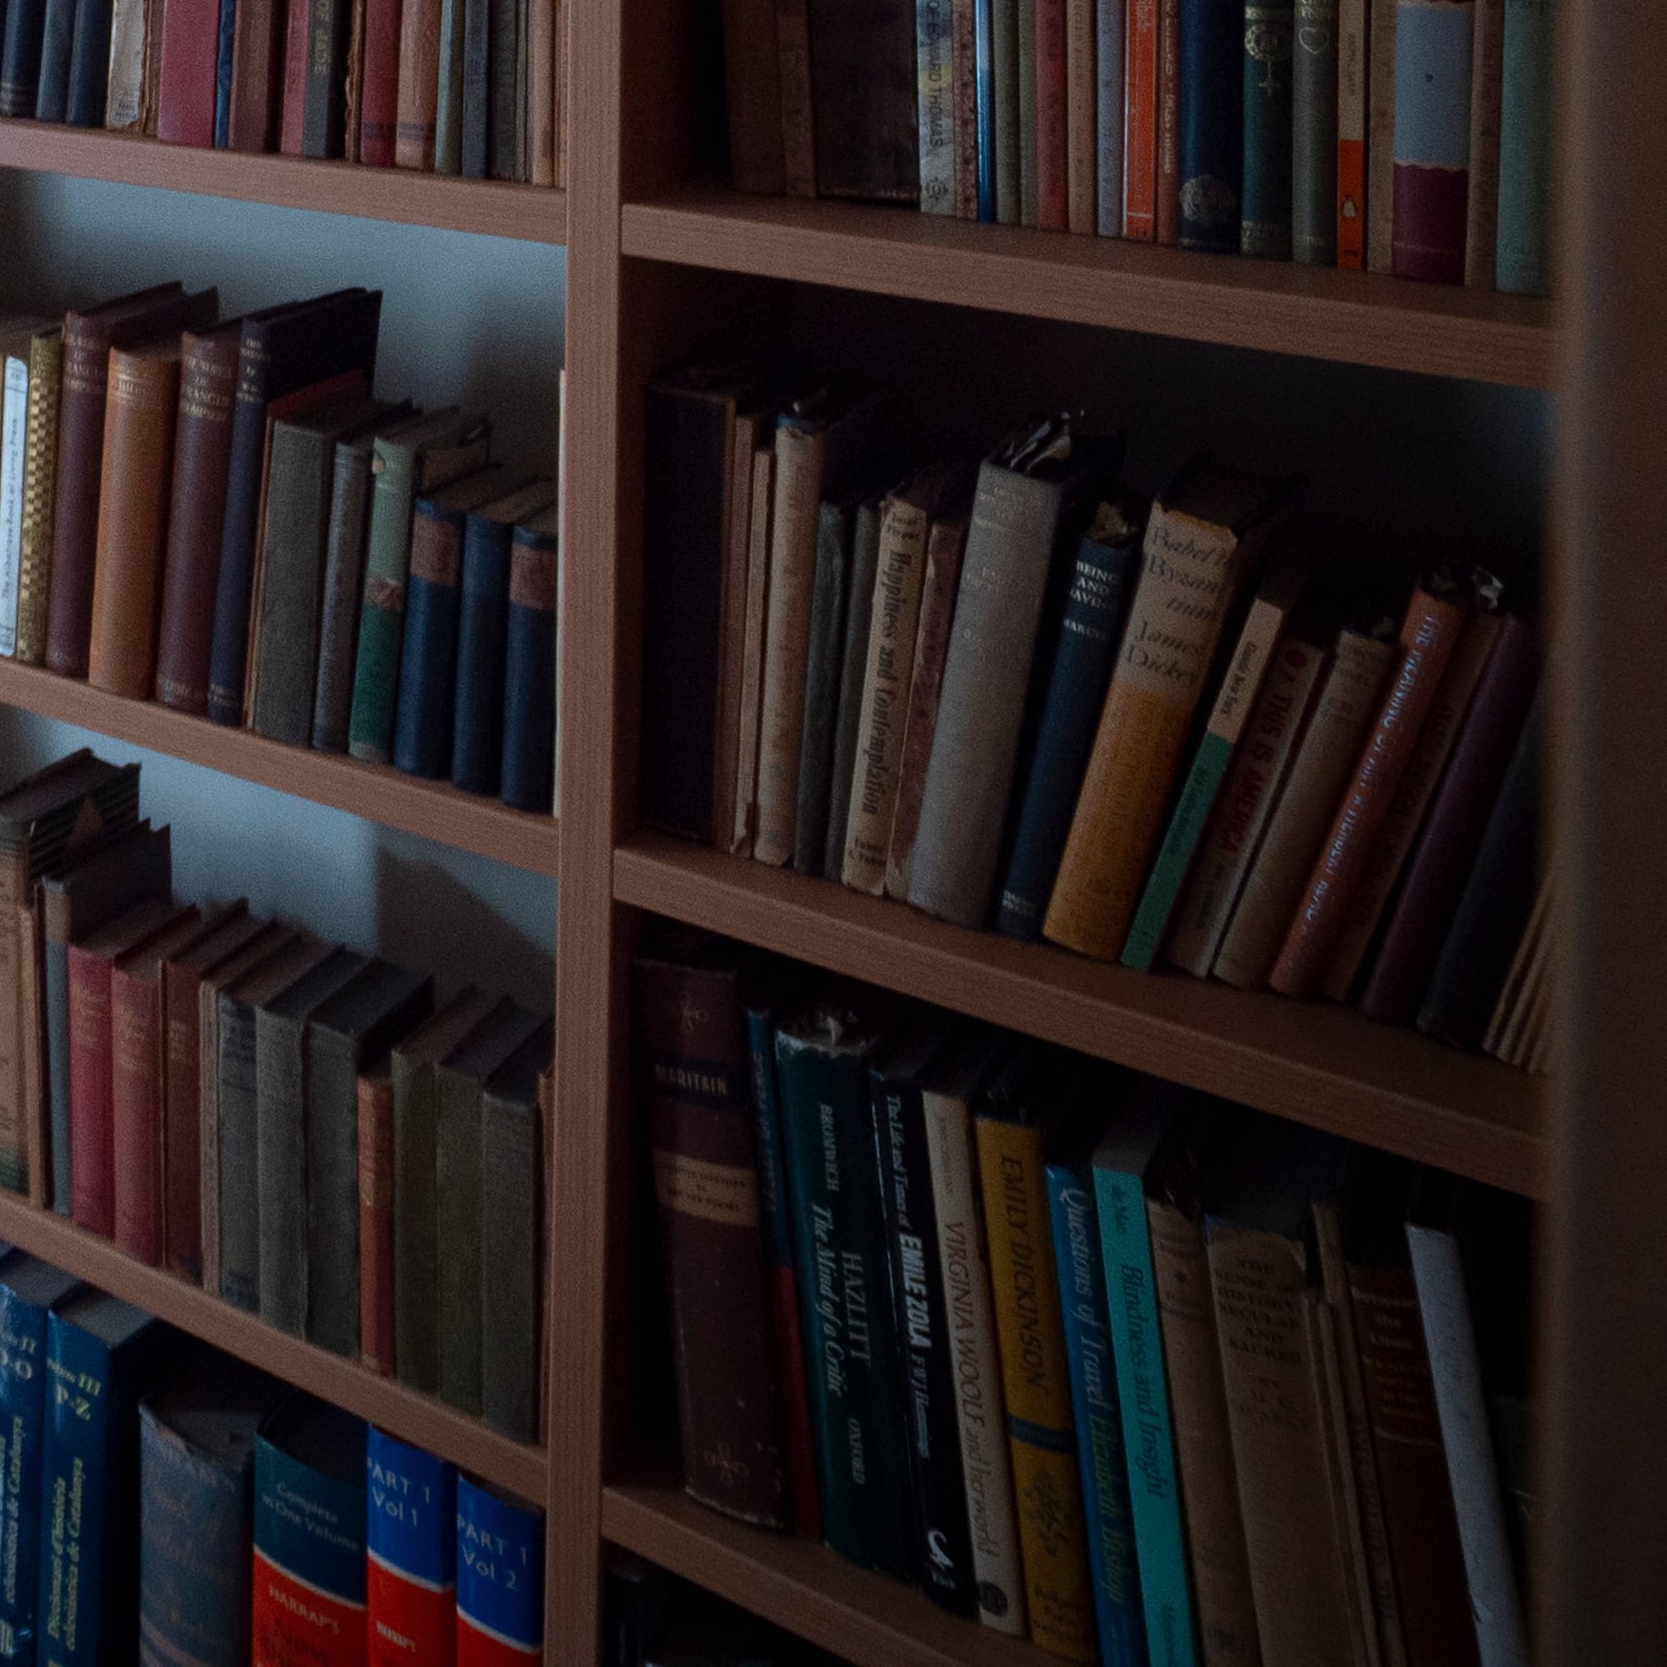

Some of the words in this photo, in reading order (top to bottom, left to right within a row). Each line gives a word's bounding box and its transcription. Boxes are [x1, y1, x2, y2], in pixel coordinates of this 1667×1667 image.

[927, 86, 945, 149] THOMAS
[1150, 526, 1216, 563] Babel
[882, 549, 913, 641] Happiness
[1134, 619, 1201, 656] James
[877, 644, 900, 684] and
[1126, 643, 1200, 686] Dickey
[1379, 648, 1426, 729] MEANING
[1260, 693, 1294, 736] THIS
[859, 687, 899, 818] Contemplation
[1250, 741, 1277, 766] IS
[887, 1094, 901, 1119] The
[889, 1120, 904, 1143] Life
[818, 1101, 840, 1192] BROMWICH
[892, 1145, 906, 1169] and
[894, 1172, 910, 1208] Times
[1000, 1153, 1032, 1237] EMILY
[811, 1202, 835, 1242] The
[1060, 1185, 1096, 1299] Questions
[816, 1244, 838, 1299] Mind
[898, 1232, 927, 1294] EMILE
[942, 1220, 977, 1328] VIRGINIA
[816, 1299, 840, 1322] of
[841, 1250, 872, 1369] HAZLITT
[905, 1294, 932, 1350] ZOLA
[1009, 1238, 1050, 1390] DICKINSON
[1076, 1303, 1096, 1328] of
[1118, 1262, 1148, 1371] Blindness
[824, 1335, 850, 1398] Critic
[956, 1331, 988, 1426] WOOLF
[1079, 1332, 1114, 1417] Travel
[55, 1385, 92, 1423] P-Z
[1133, 1372, 1154, 1414] and
[848, 1417, 866, 1486] OXFORD
[965, 1427, 988, 1462] and
[1135, 1419, 1169, 1499] Insight
[276, 1481, 339, 1526] Complete
[422, 1485, 432, 1506] 1
[972, 1464, 993, 1497] her
[274, 1498, 303, 1527] One
[304, 1515, 360, 1552] Volume
[410, 1508, 419, 1528] 1
[457, 1512, 508, 1558] PART
[519, 1546, 528, 1567] 1
[976, 1497, 1001, 1558] world
[505, 1570, 518, 1591] 2
[267, 1584, 341, 1635] HARRAP'S
